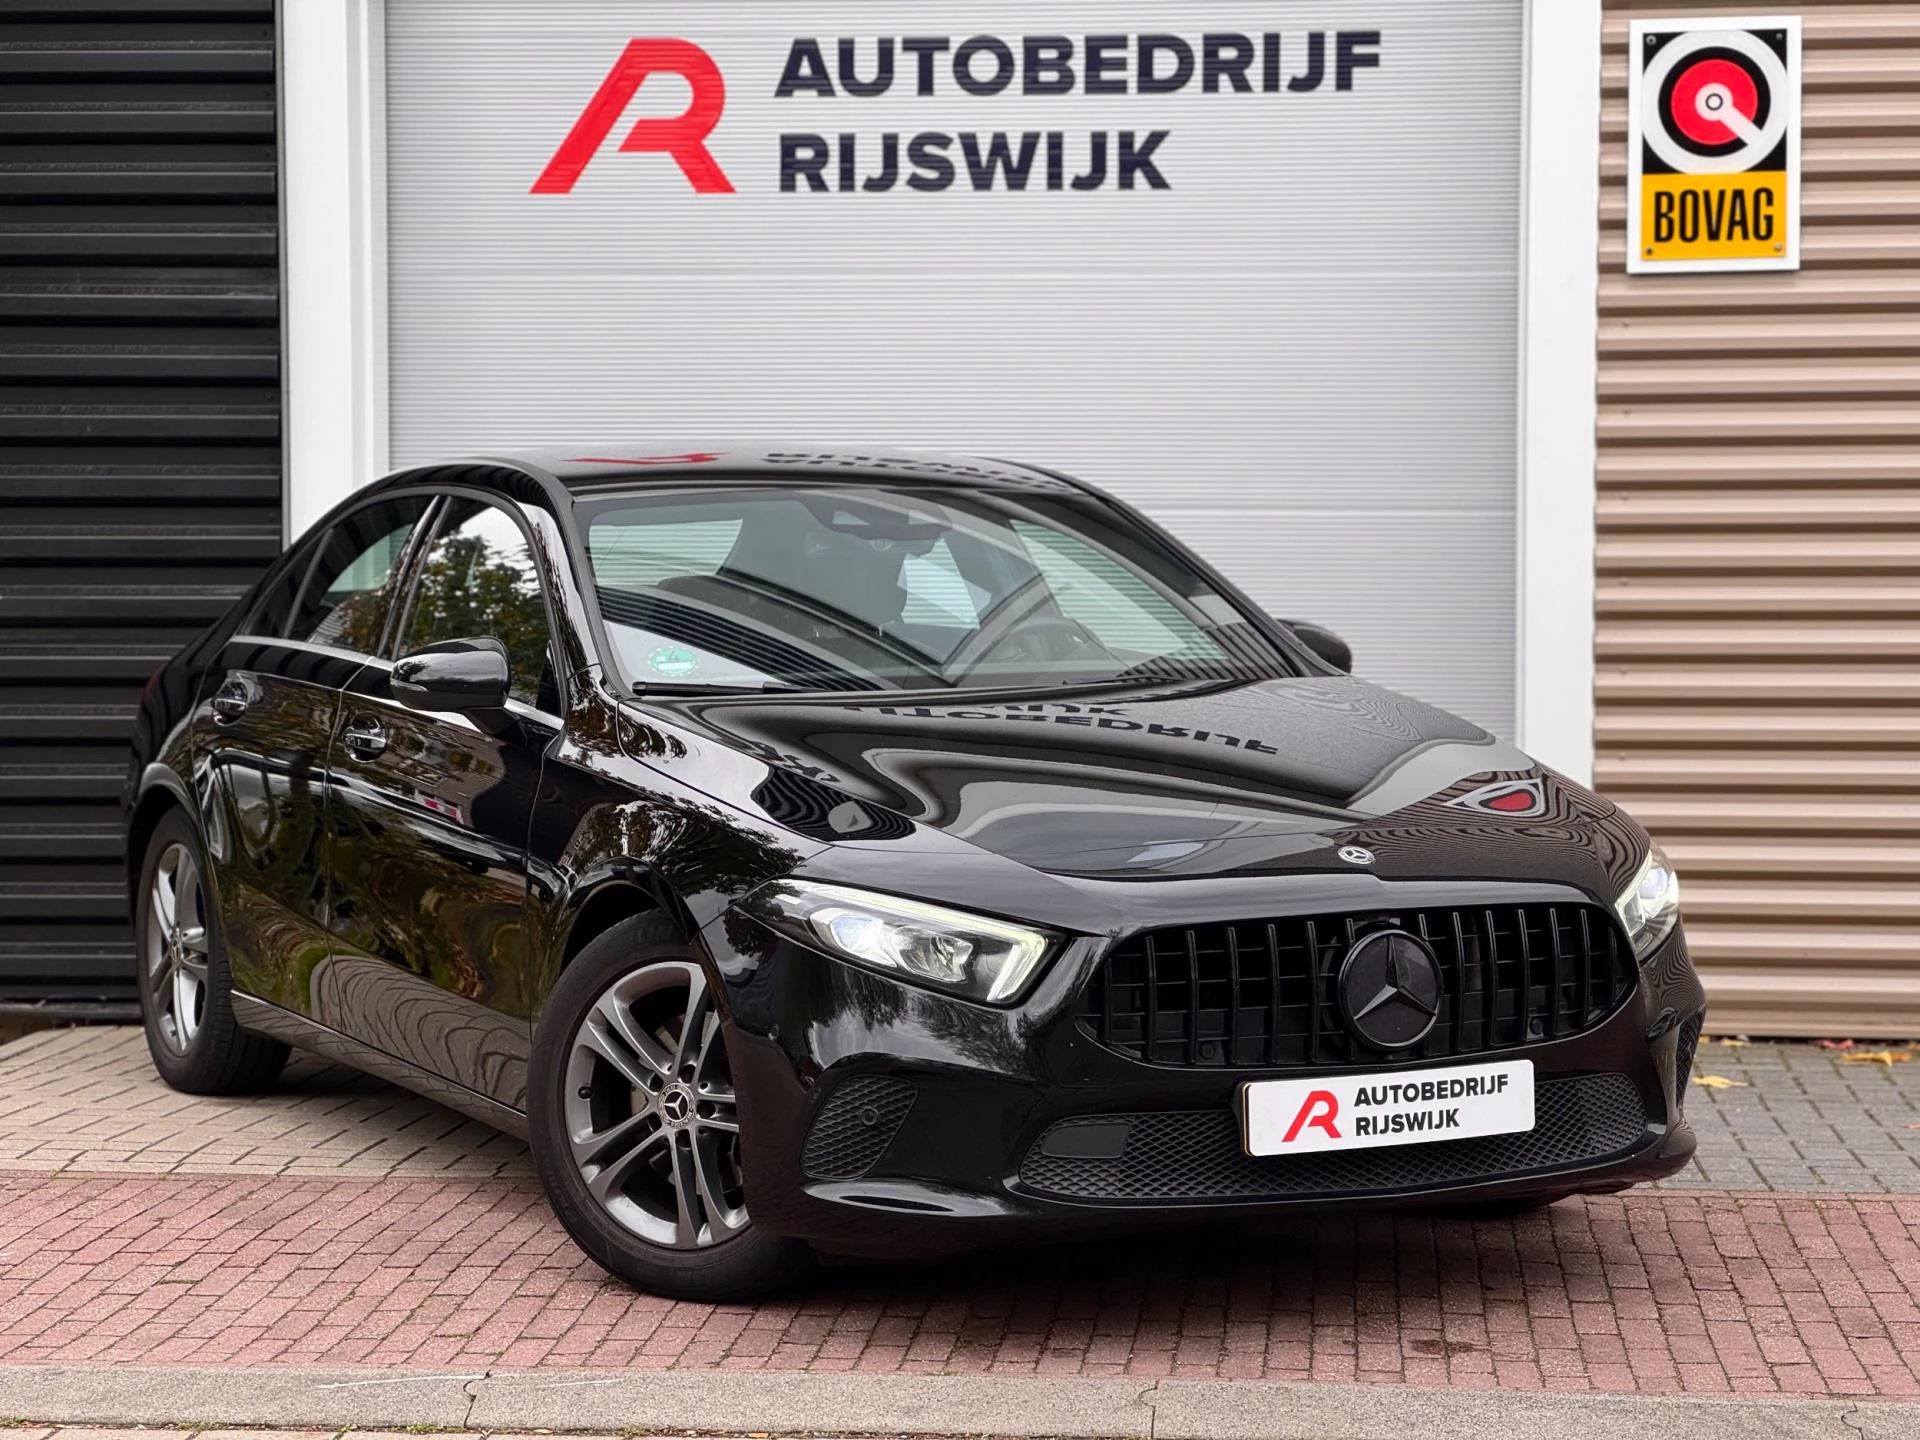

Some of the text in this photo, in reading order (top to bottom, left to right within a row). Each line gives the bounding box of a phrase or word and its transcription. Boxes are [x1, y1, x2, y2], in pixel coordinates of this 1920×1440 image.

[775, 30, 1382, 98] AUTOBEDRIJF
[779, 130, 1172, 193] RIJSWIJK
[1654, 187, 1775, 243] BOVAG
[1354, 1073, 1509, 1107] AUTOBEDRIJF
[1355, 1108, 1460, 1137] RIJSWIJK
